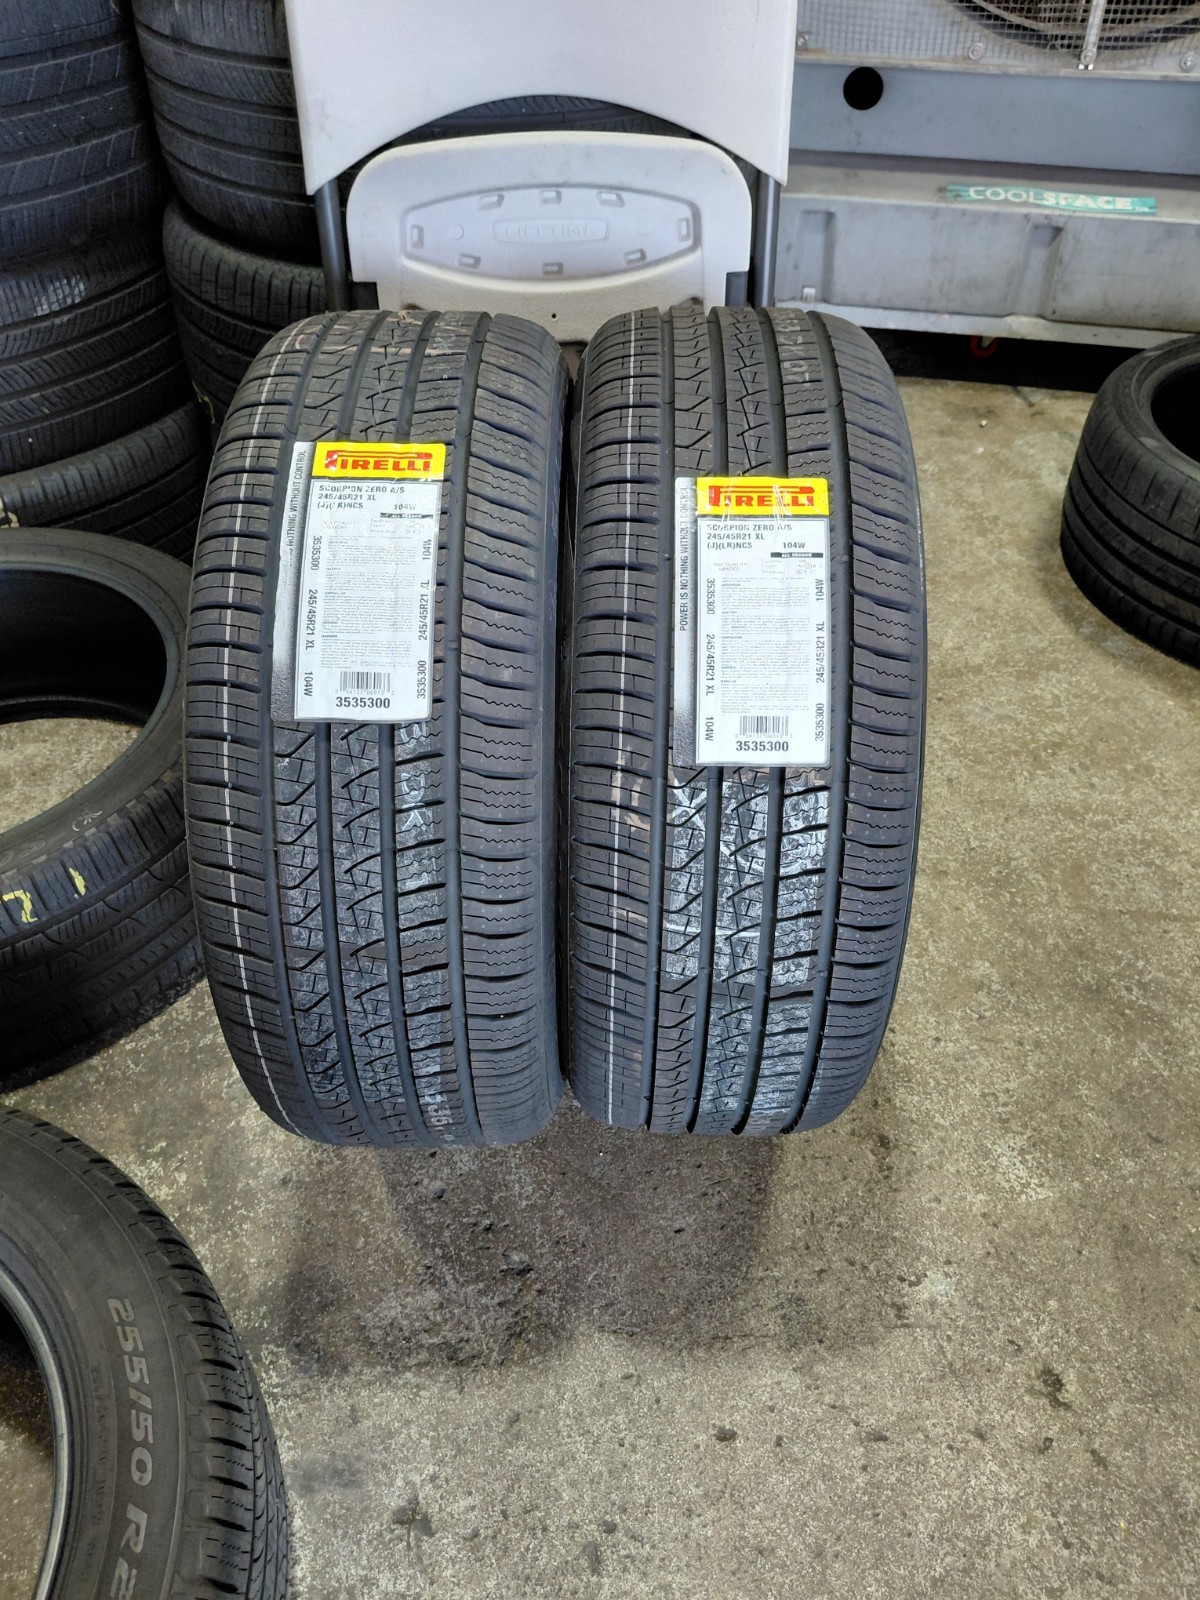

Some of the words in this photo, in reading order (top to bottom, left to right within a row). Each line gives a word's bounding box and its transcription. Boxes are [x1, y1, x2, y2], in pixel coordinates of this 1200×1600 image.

[969, 187, 1133, 210] COOLSPACE
[294, 449, 307, 480] CONTROL
[324, 450, 433, 471] PIRELLI
[288, 481, 301, 513] WITHOUT
[318, 493, 363, 501] 245/45R21
[708, 486, 815, 507] PIRELLI
[680, 520, 689, 555] WITHOUT
[707, 524, 750, 532] SCORPION
[707, 532, 751, 540] 245/45R21
[311, 535, 323, 571] 3535300
[422, 538, 432, 561] 104W
[707, 541, 753, 550] (J)(LR)NCS
[680, 556, 689, 592] NOTHING
[680, 592, 689, 601] IS
[706, 578, 716, 615] 3535300
[815, 578, 825, 602] 104W
[305, 588, 318, 637] 245/45R21
[418, 594, 429, 641] 245/45R21
[680, 603, 689, 632] POWER
[816, 621, 825, 632] XL
[305, 638, 315, 651] XL
[706, 633, 716, 682] 245/45R21
[815, 636, 825, 684] 245/45R21
[303, 671, 314, 697] 104W
[416, 660, 427, 700] 3535300
[705, 684, 715, 697] XL
[335, 696, 391, 708] 3535300
[705, 716, 714, 742] 104W
[814, 703, 825, 742] 3535300
[735, 740, 789, 752] 3535300
[106, 1298, 154, 1486] 255/50
